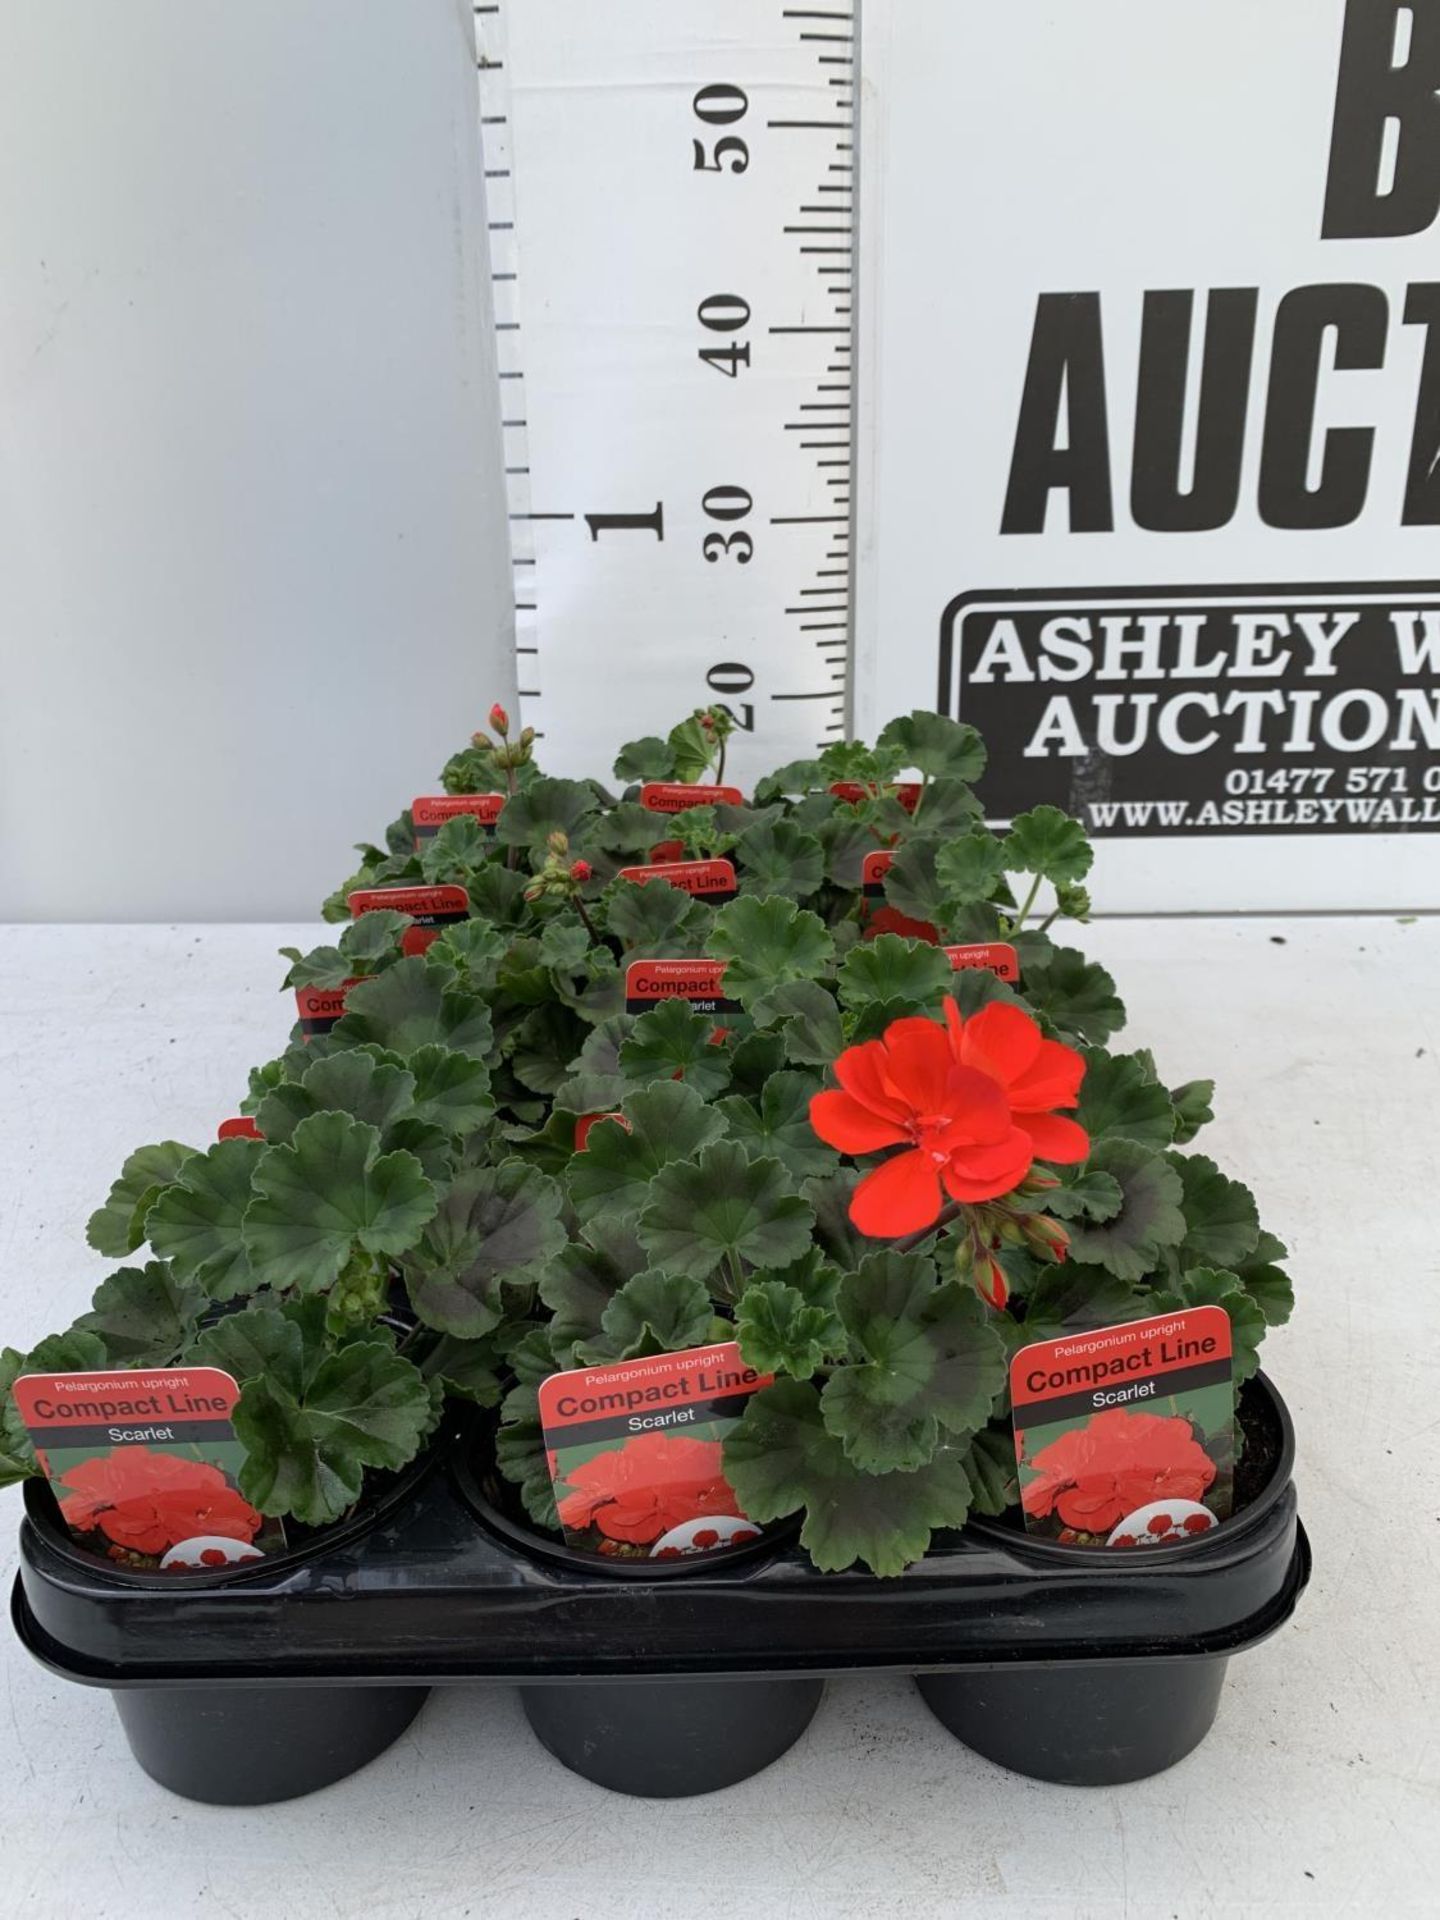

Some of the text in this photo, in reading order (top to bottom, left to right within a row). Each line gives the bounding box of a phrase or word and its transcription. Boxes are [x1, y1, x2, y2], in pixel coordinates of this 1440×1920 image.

[693, 83, 749, 174] 50
[698, 294, 751, 378] 40
[584, 501, 663, 542] 1
[702, 485, 753, 564] 30
[969, 612, 1360, 683] ASHLEY
[1023, 689, 1440, 757] AUCTION
[1224, 767, 1335, 795] 01477
[1345, 767, 1407, 793] 571
[1088, 796, 1440, 828] WWW.ASHLEYWALL
[697, 876, 727, 889] Line
[636, 978, 716, 994] Compact
[691, 1001, 716, 1011] arlet
[1055, 1320, 1186, 1359] Pelargonium upright
[585, 1353, 726, 1386] Pelargonium upright
[1026, 1337, 1217, 1393] Compact Line
[54, 1377, 189, 1393] Pelargonium upright
[557, 1368, 758, 1417] Compact Line
[1092, 1381, 1156, 1408] Scarlet
[33, 1393, 228, 1420] Compact Line
[628, 1408, 696, 1431] Scarlet
[108, 1427, 175, 1442] Scarlet
